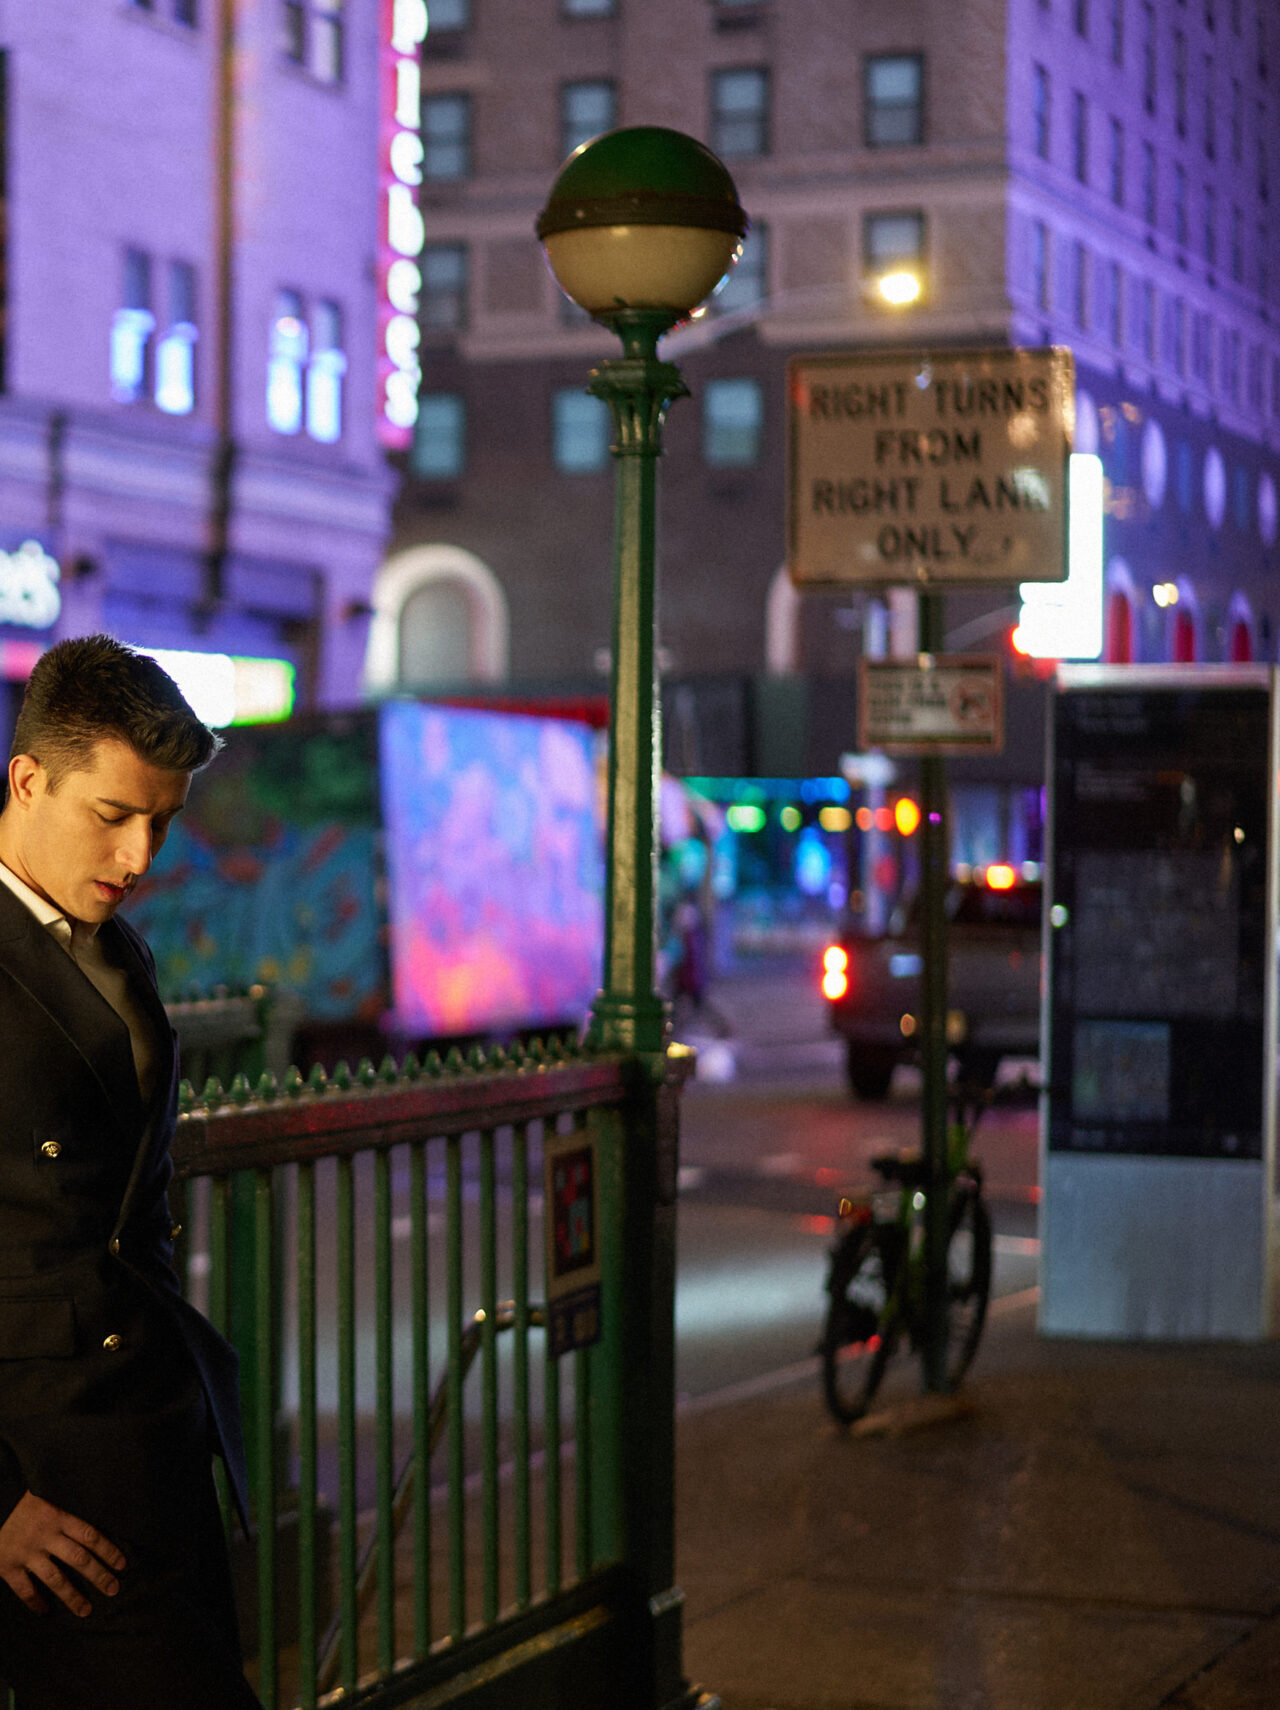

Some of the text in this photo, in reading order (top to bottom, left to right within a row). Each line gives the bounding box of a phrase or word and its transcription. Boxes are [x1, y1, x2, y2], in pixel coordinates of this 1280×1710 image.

[808, 377, 1049, 420] RIGHT TURNS
[874, 427, 982, 467] FROM
[811, 477, 919, 515] RIGHT
[876, 523, 976, 562] ONLY
